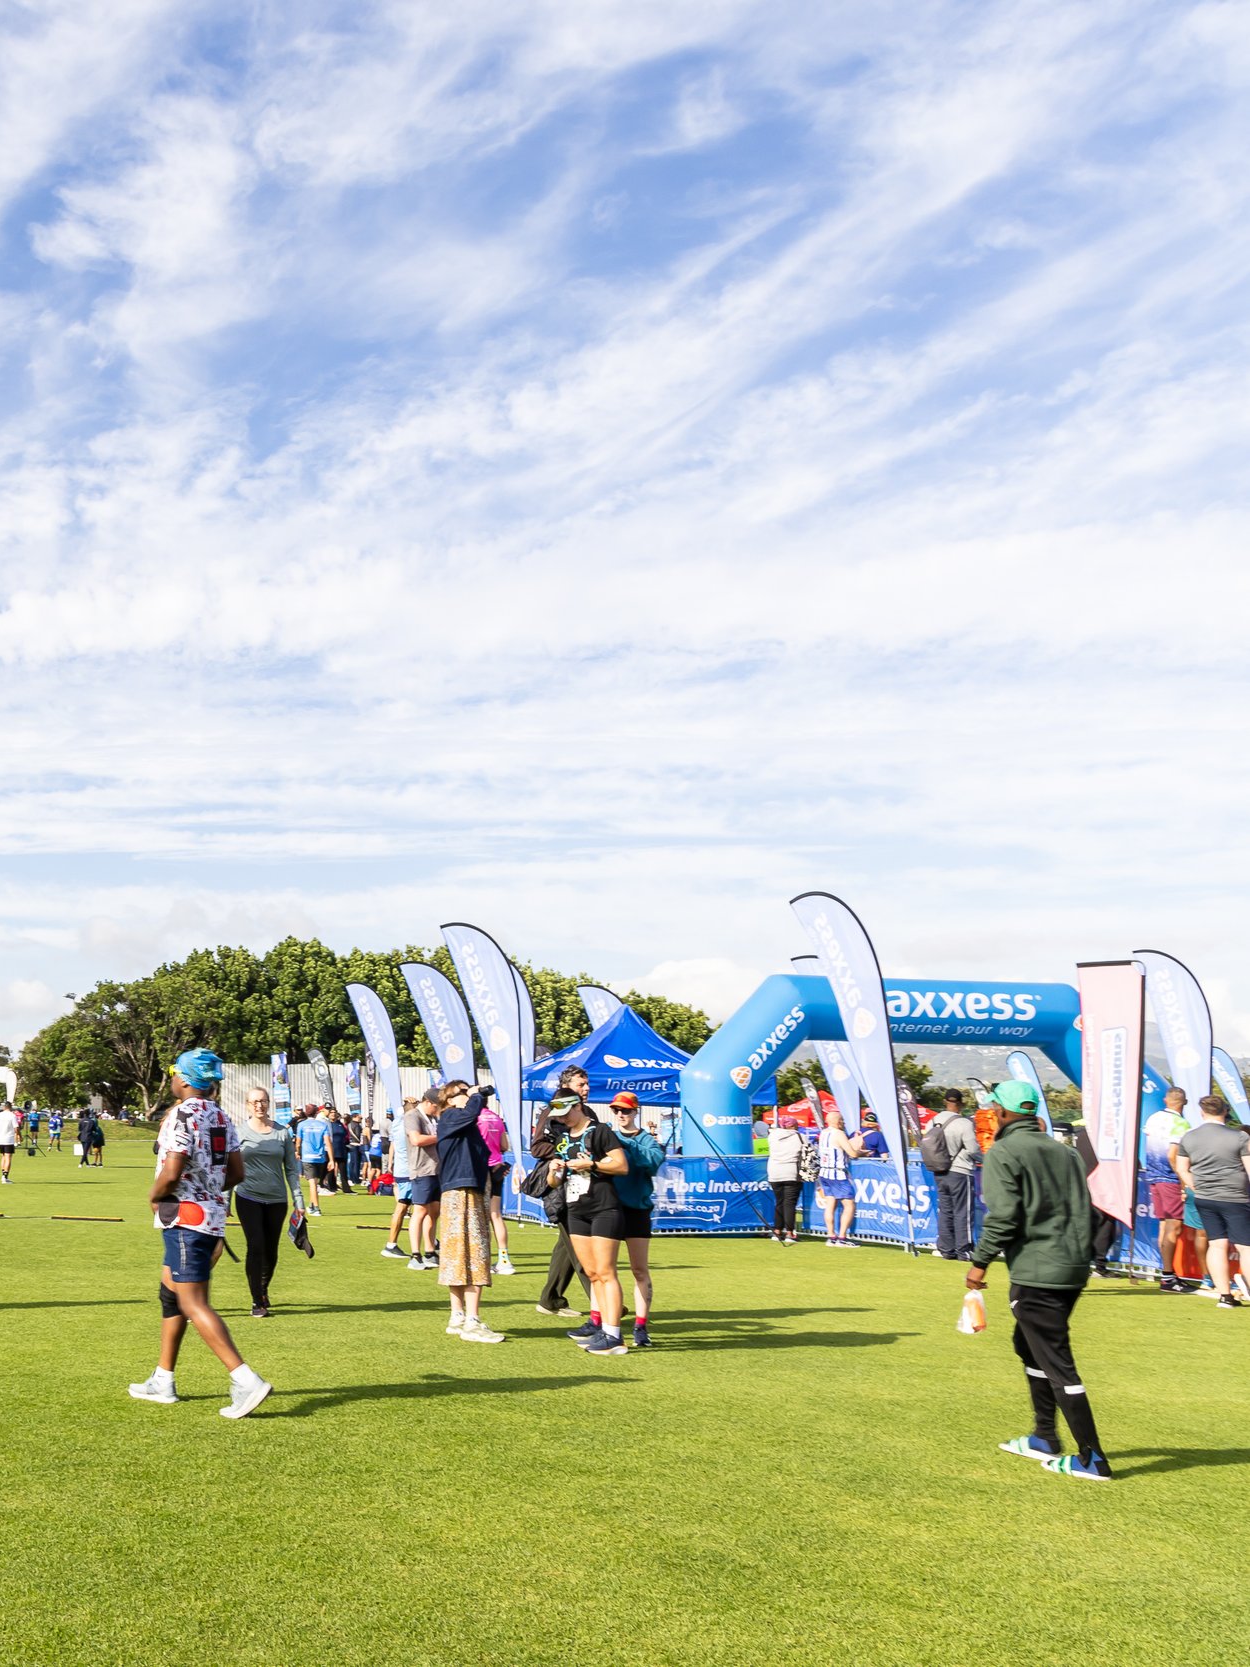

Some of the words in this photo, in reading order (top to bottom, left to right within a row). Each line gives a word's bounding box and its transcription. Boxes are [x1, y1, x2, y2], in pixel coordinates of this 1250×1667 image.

[886, 990, 1037, 1021] axxess
[747, 1006, 805, 1070] axxess
[952, 1025, 994, 1036] your
[999, 1026, 1033, 1038] way
[606, 1078, 668, 1091] Internet
[662, 1180, 706, 1193] Fibre
[881, 1212, 905, 1225] your
